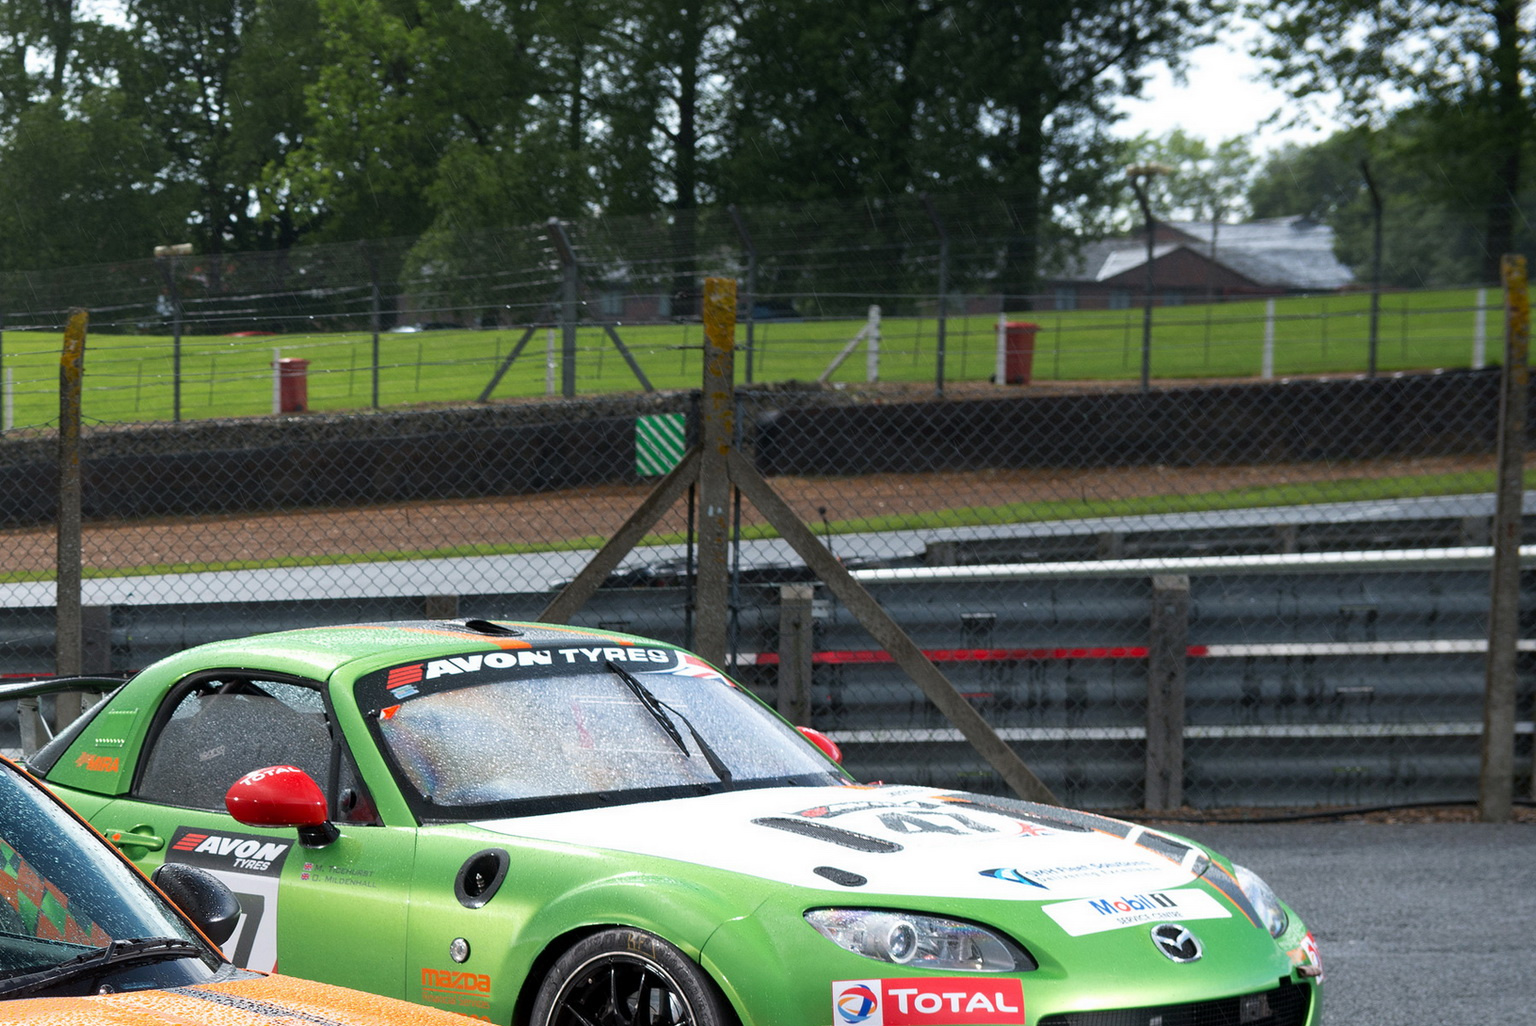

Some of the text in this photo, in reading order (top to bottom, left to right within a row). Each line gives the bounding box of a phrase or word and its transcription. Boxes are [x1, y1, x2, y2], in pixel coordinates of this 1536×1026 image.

[425, 647, 670, 680] AVON TYRES
[86, 755, 120, 773] MIRA
[239, 765, 301, 786] TOTAL
[194, 836, 289, 862] AVON
[233, 857, 272, 871] TYRES
[324, 875, 377, 888] MILDENHALL
[1089, 894, 1156, 916] Mobil
[1116, 913, 1151, 926] SERVICE
[421, 968, 491, 993] mazda
[888, 988, 1019, 1014] TOTAL
